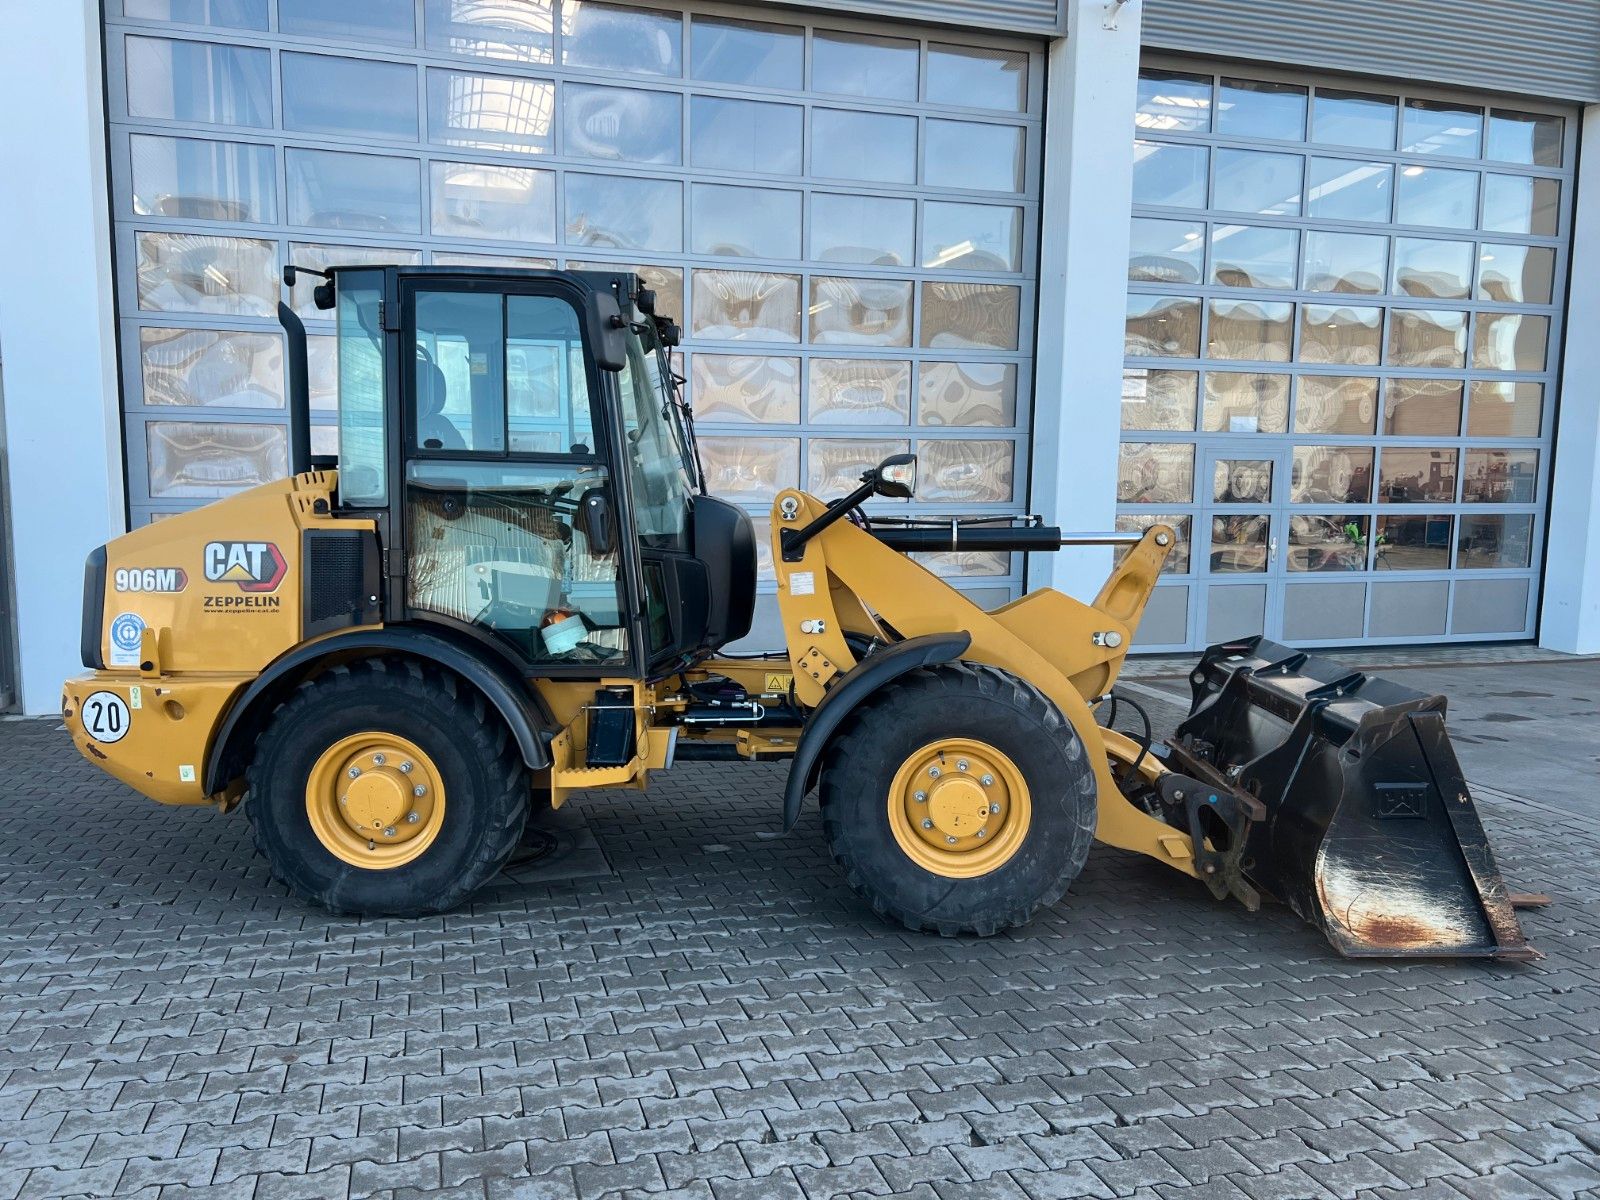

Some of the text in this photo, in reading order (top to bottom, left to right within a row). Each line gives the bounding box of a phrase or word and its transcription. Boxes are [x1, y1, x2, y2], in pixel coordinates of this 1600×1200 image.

[205, 542, 267, 581] CAT
[115, 569, 176, 592] 906M
[204, 596, 280, 607] ZEPPELIN
[91, 701, 121, 733] 20
